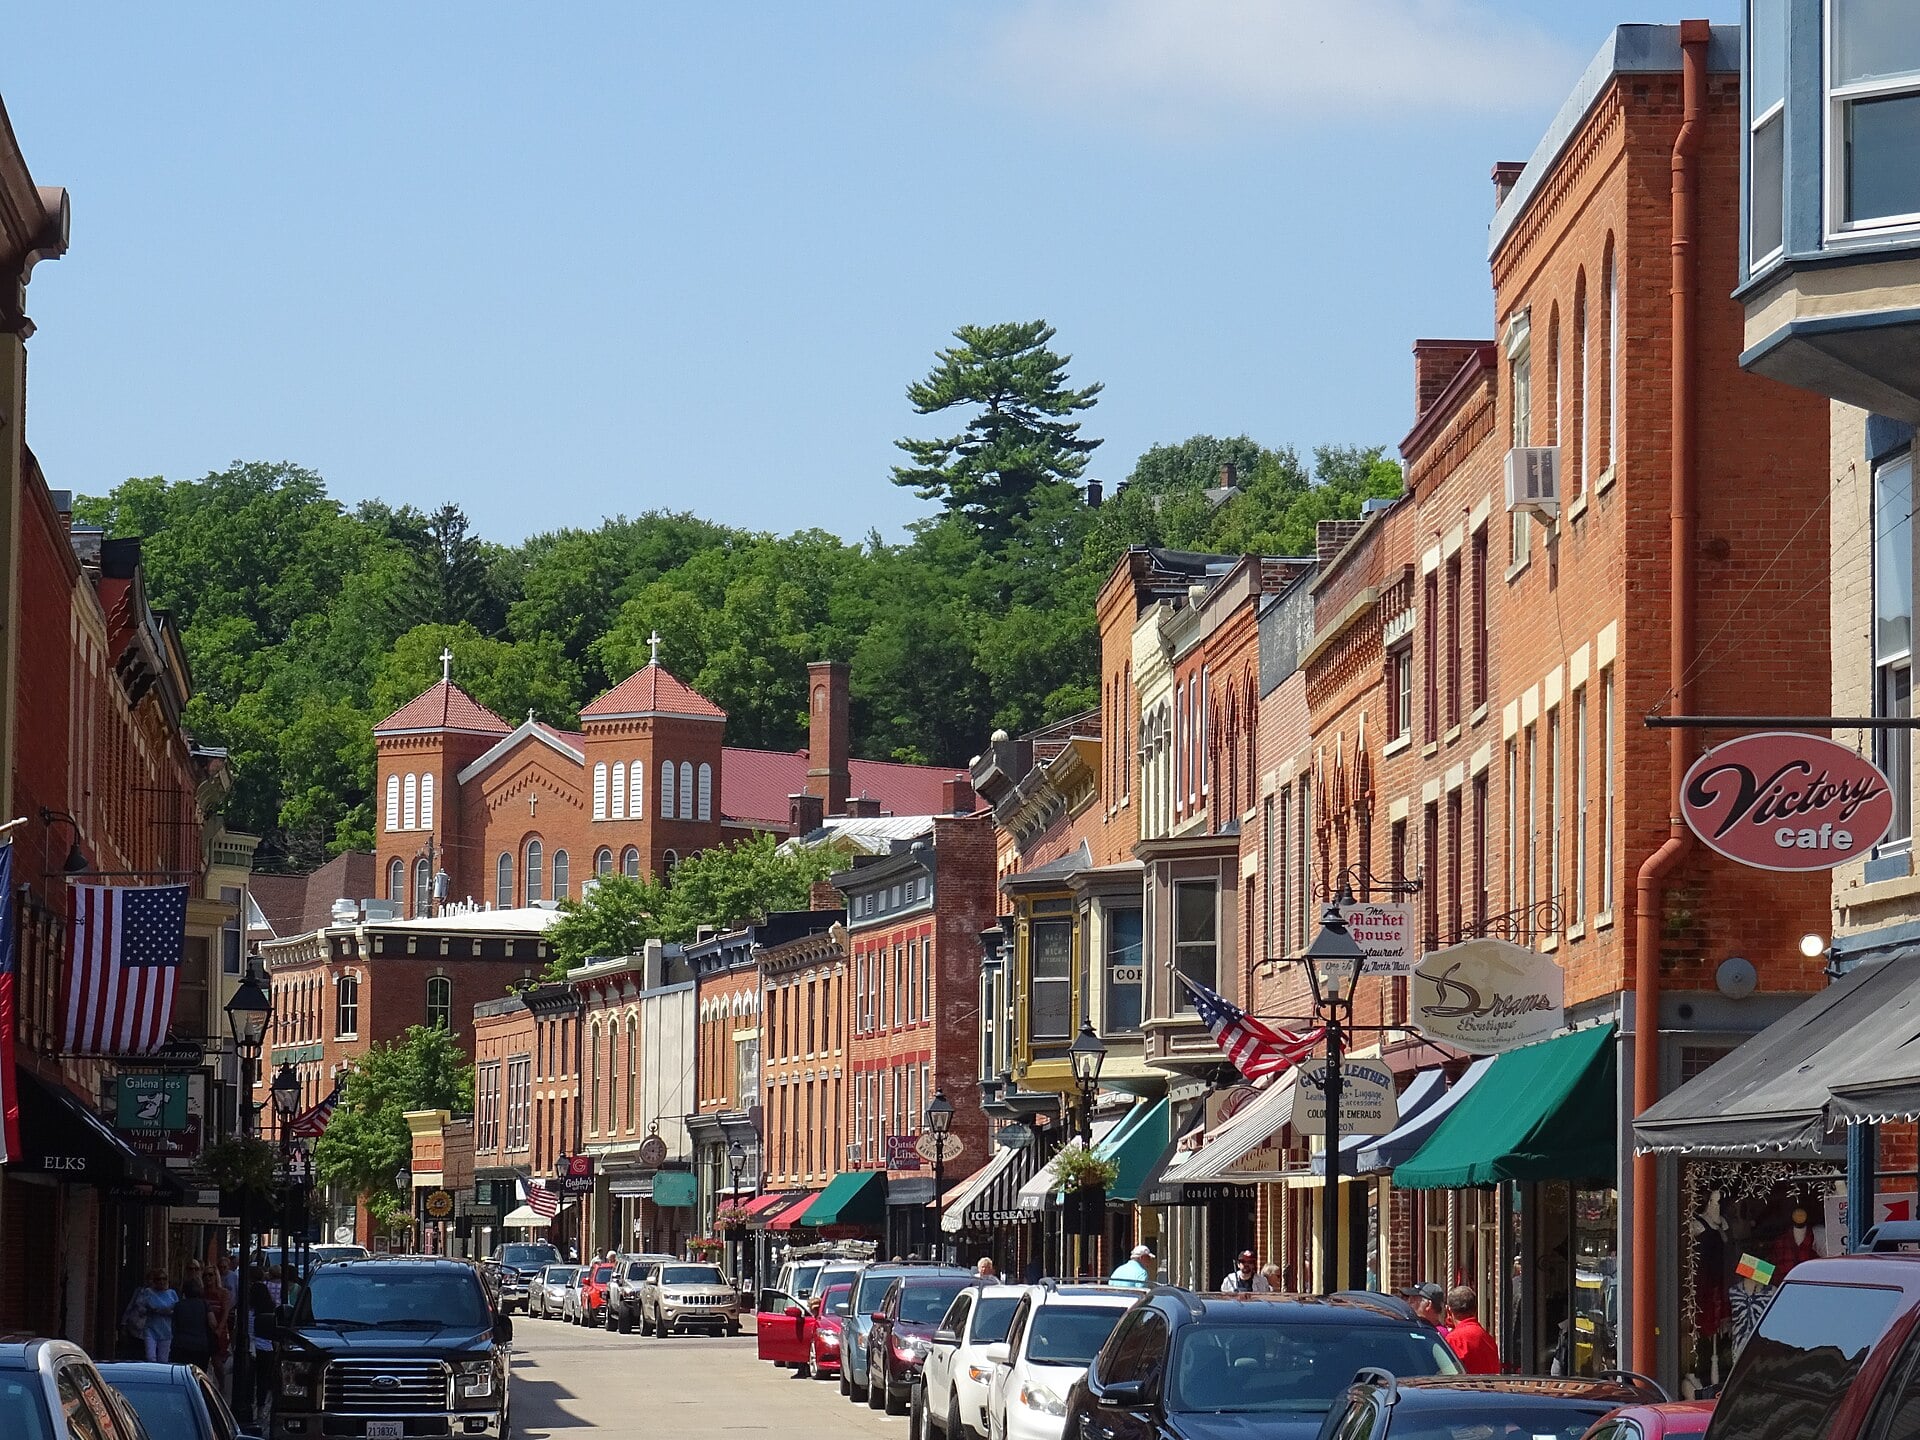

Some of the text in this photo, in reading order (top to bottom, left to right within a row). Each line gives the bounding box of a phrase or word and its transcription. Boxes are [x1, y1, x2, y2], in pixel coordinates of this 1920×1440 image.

[1688, 760, 1888, 840] Victory
[1775, 823, 1853, 850] cafe
[1366, 906, 1384, 916] The
[1349, 912, 1404, 926] Market
[1353, 928, 1402, 943] House
[1360, 947, 1404, 957] staurant
[1371, 961, 1391, 972] North
[1392, 961, 1411, 972] Main
[1415, 962, 1557, 1018] Dreams
[1457, 1015, 1518, 1036] Boutique
[125, 1077, 159, 1089] Galena
[1344, 1063, 1391, 1090] LEATHER
[1346, 1109, 1382, 1119] EMERALDS
[43, 1156, 86, 1170] ELKS
[565, 1177, 592, 1190] Gabby's
[1186, 1186, 1217, 1198] candle
[1233, 1186, 1255, 1198] bath
[971, 1209, 1035, 1221] ICE CREAM
